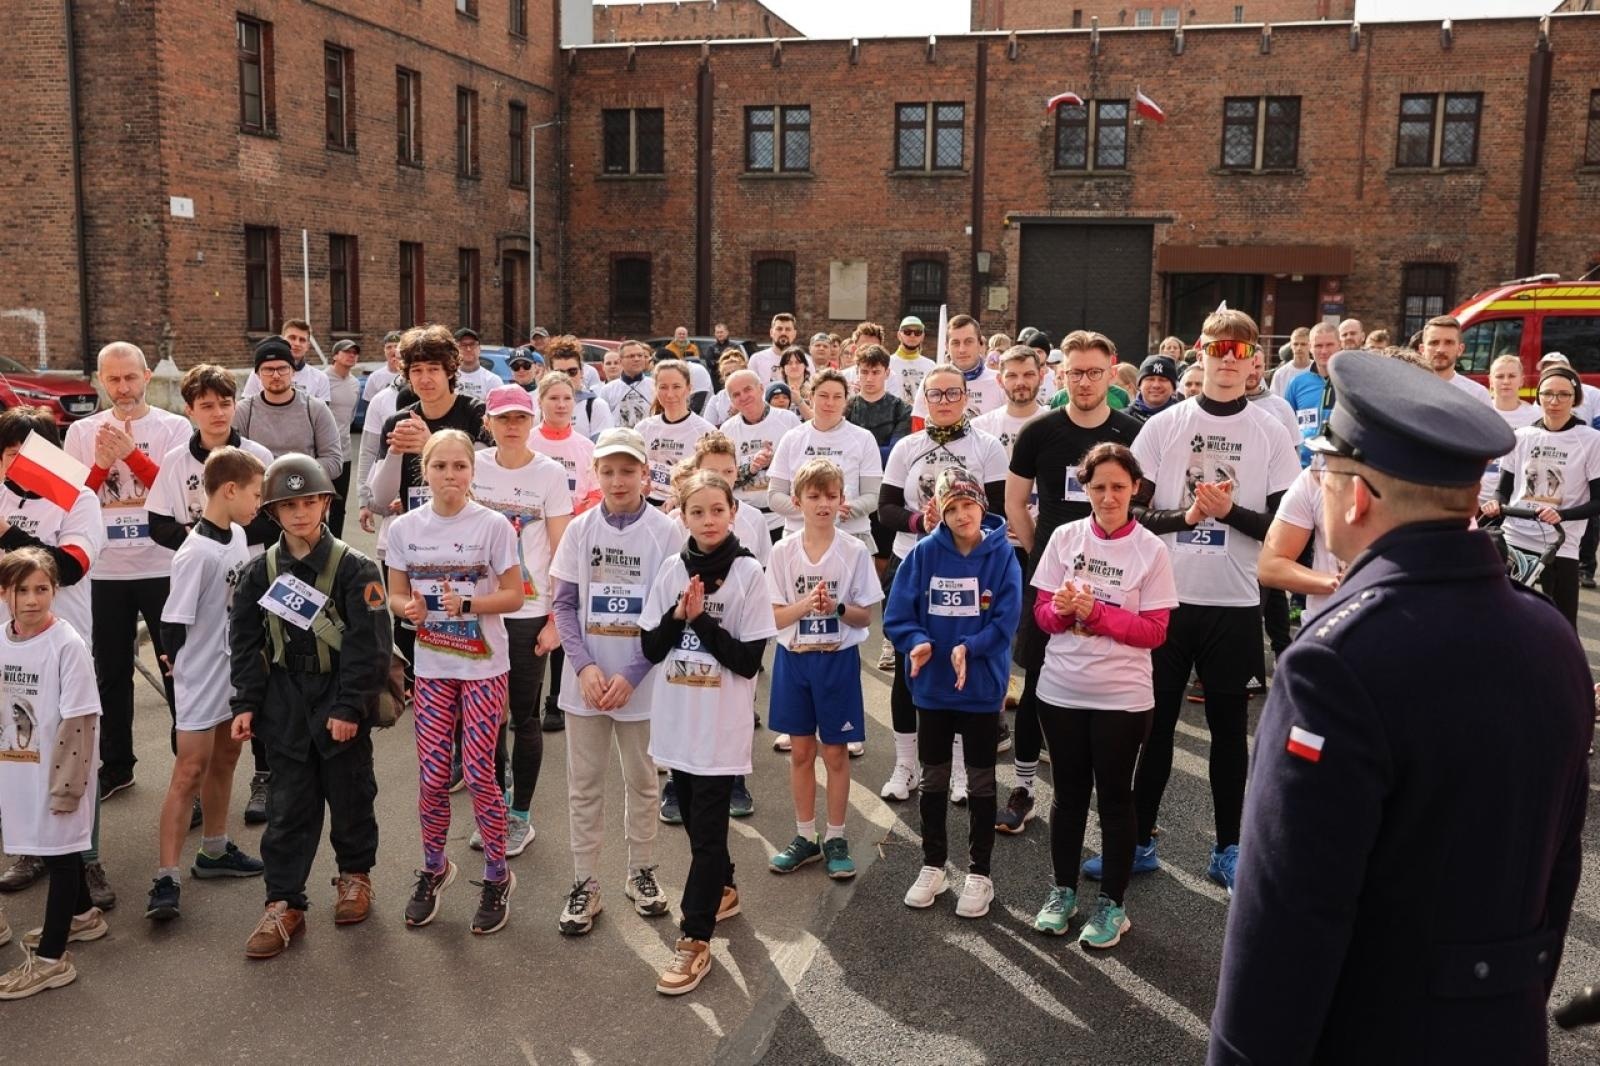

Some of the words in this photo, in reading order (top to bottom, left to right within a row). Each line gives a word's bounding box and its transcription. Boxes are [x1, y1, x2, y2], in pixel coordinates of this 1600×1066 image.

[1207, 441, 1242, 451] WILCZYM
[1542, 450, 1568, 458] WILCZYM
[653, 471, 666, 482] 38
[121, 525, 139, 538] 13
[1191, 530, 1211, 544] 25
[605, 554, 641, 566] WILCZYM
[1088, 564, 1124, 577] WILCZYM
[282, 592, 305, 611] 48
[607, 598, 629, 612] 69
[942, 591, 962, 606] 36
[703, 601, 725, 612] CZYM
[809, 619, 827, 633] 41
[681, 634, 701, 650] 89
[4, 671, 39, 683] WILCZYM
